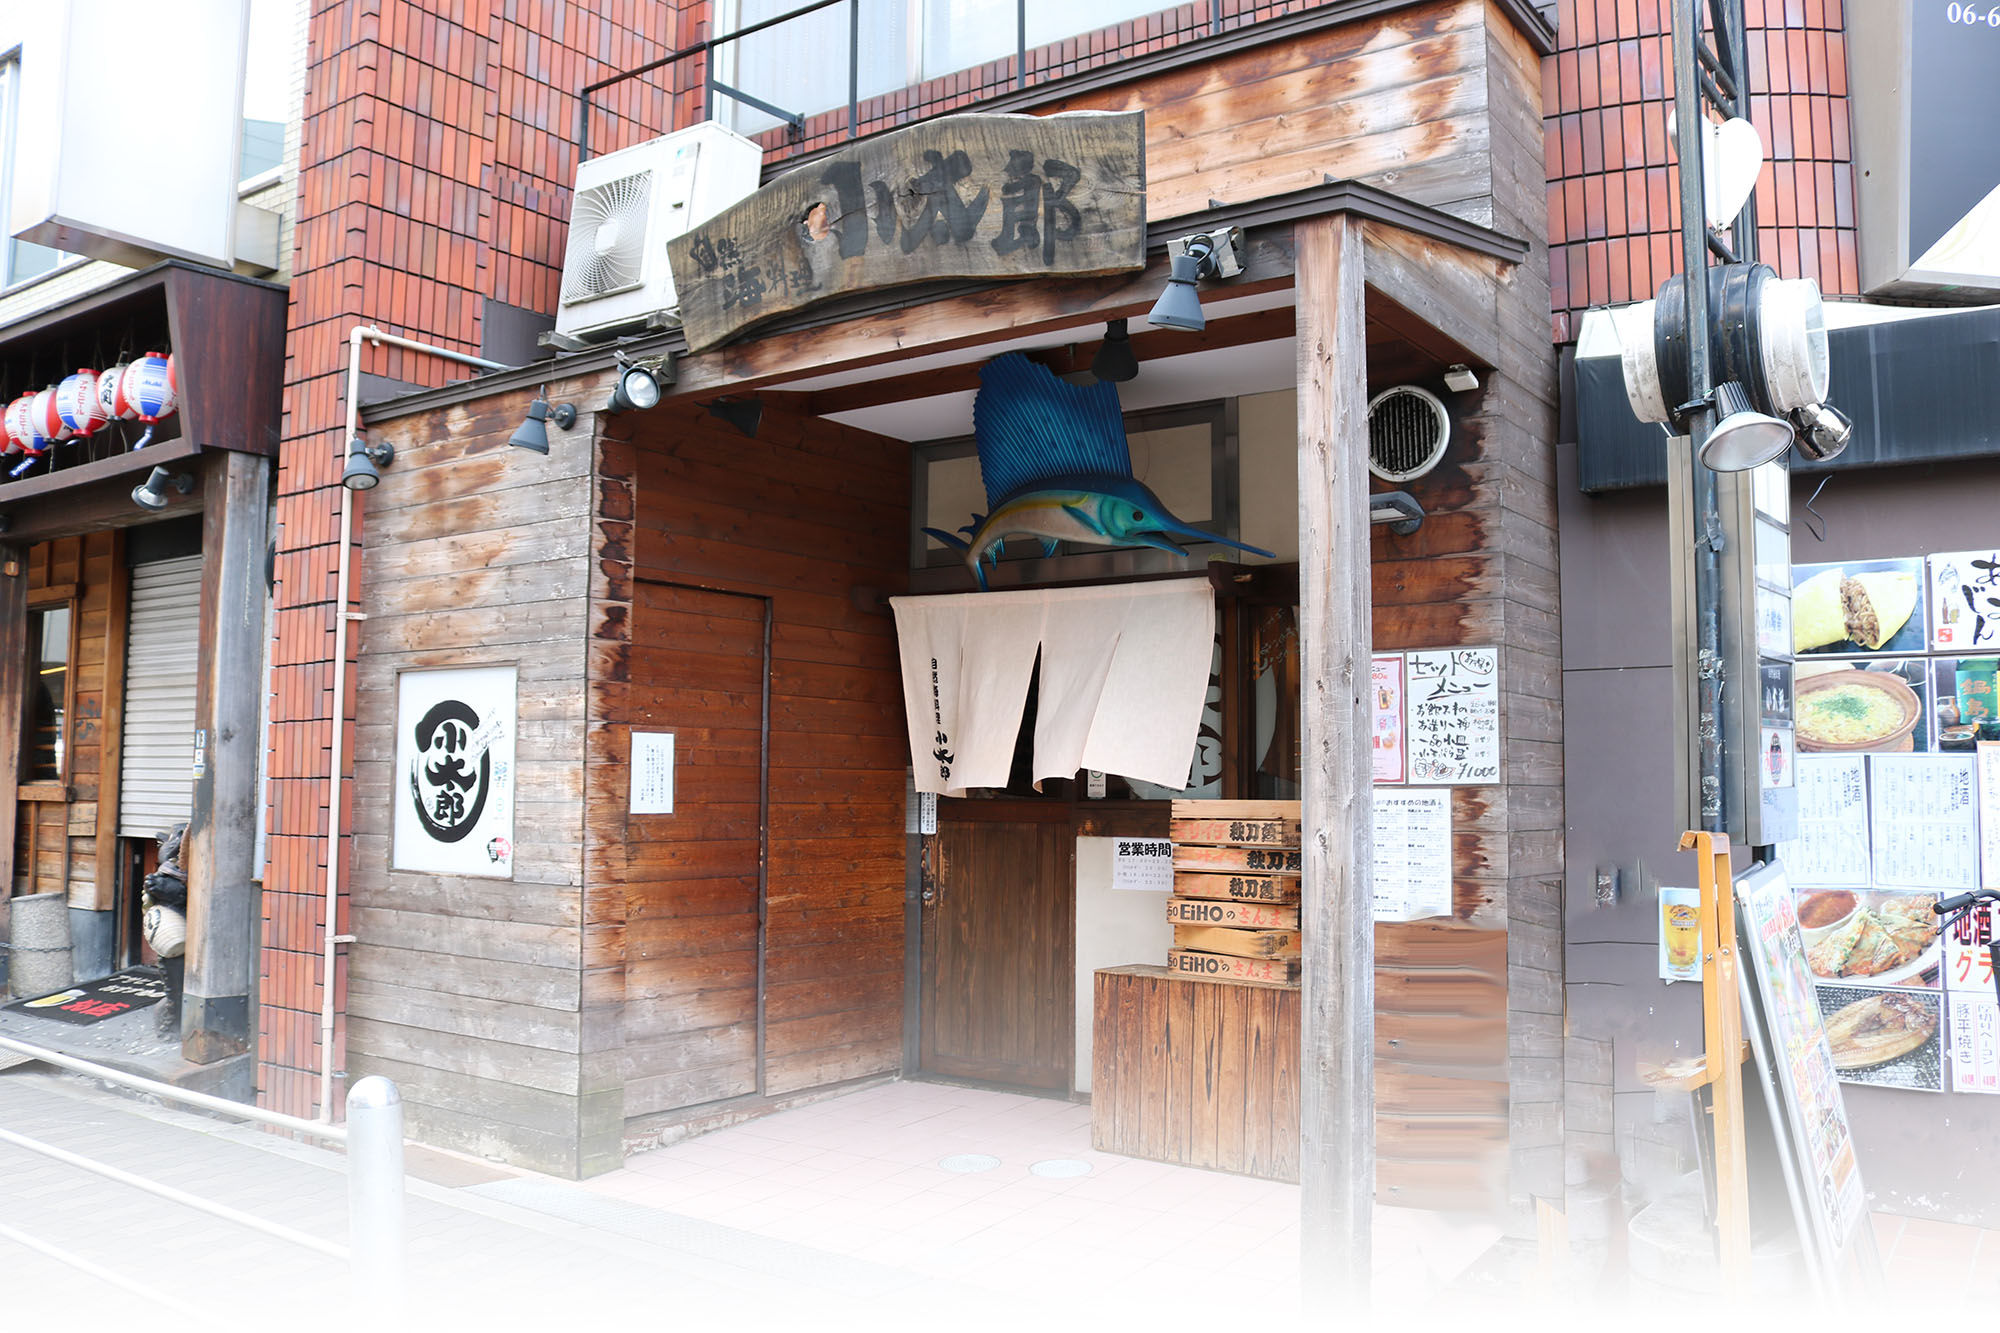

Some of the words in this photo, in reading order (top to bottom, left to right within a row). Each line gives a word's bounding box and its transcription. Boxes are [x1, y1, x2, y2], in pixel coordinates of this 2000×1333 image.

[819, 149, 1082, 267] 小太郎
[1409, 651, 1460, 676] セット
[1427, 678, 1491, 697] メニュー
[425, 722, 477, 826] 小太郎
[1118, 842, 1171, 857] 営業時間
